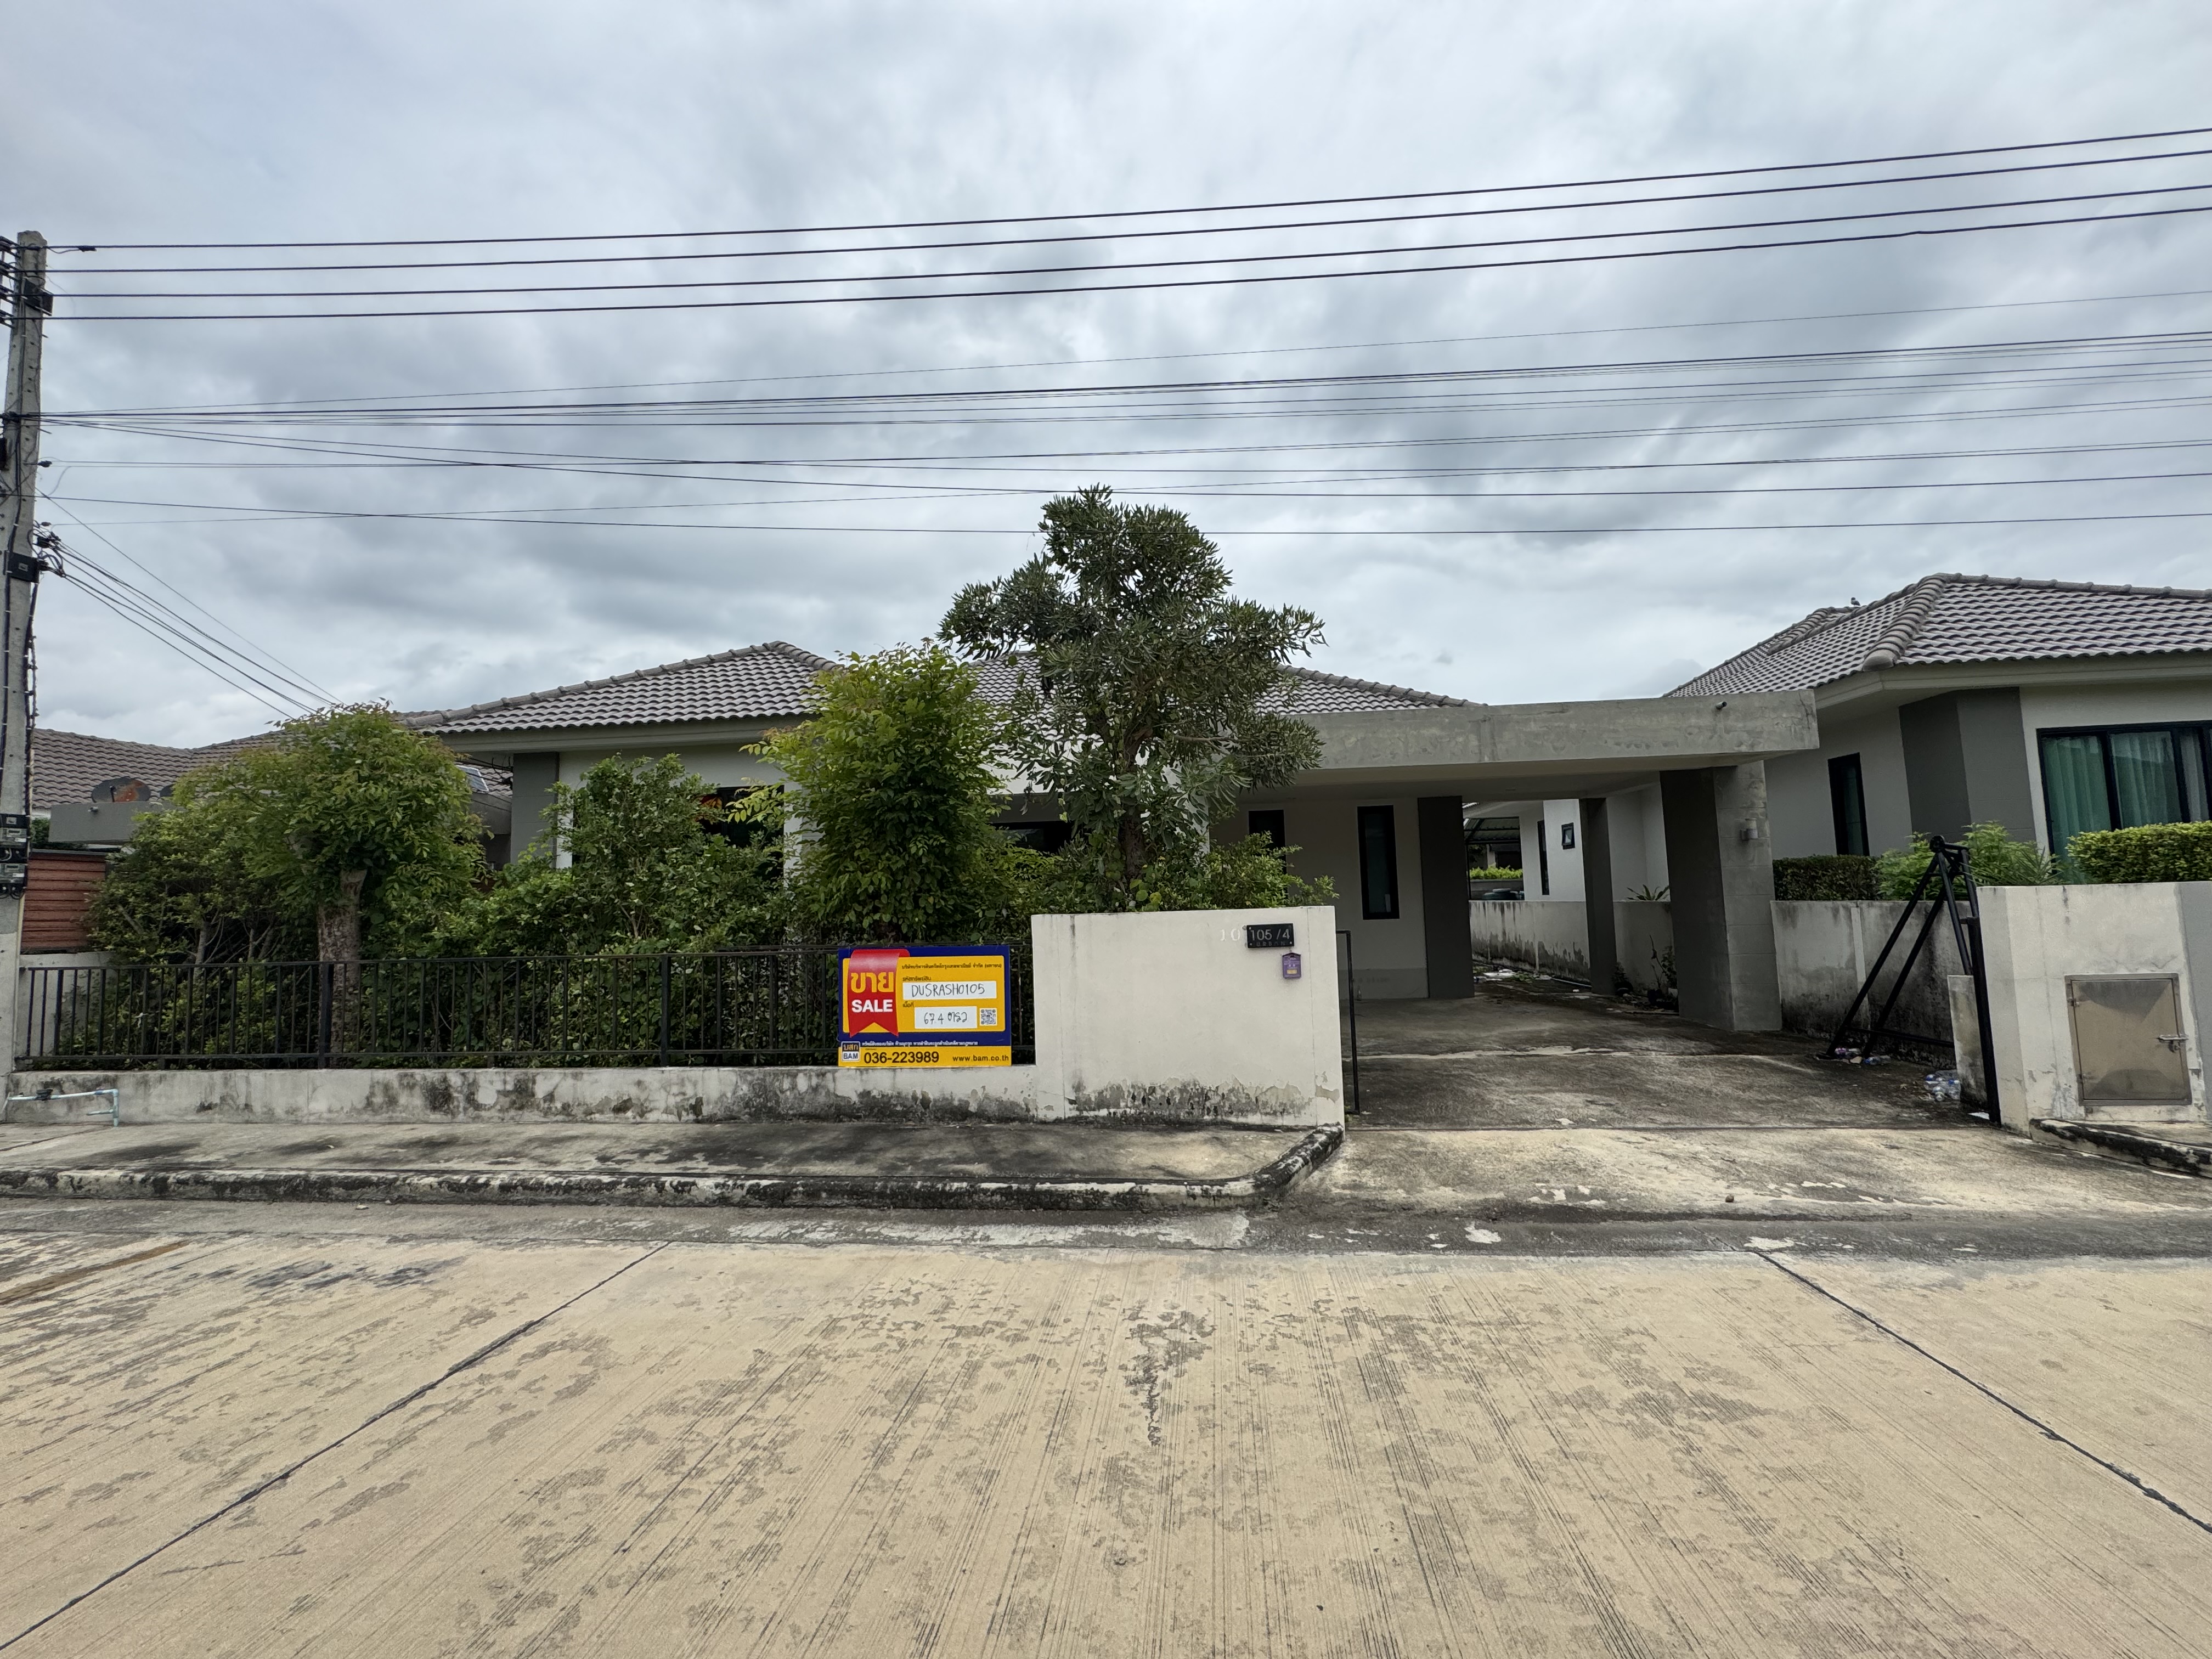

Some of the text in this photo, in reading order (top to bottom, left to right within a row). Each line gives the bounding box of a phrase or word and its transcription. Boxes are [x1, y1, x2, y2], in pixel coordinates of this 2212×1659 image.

[851, 972, 894, 993] ขาย
[851, 999, 893, 1013] SALE
[864, 1051, 939, 1064] 036-223989
